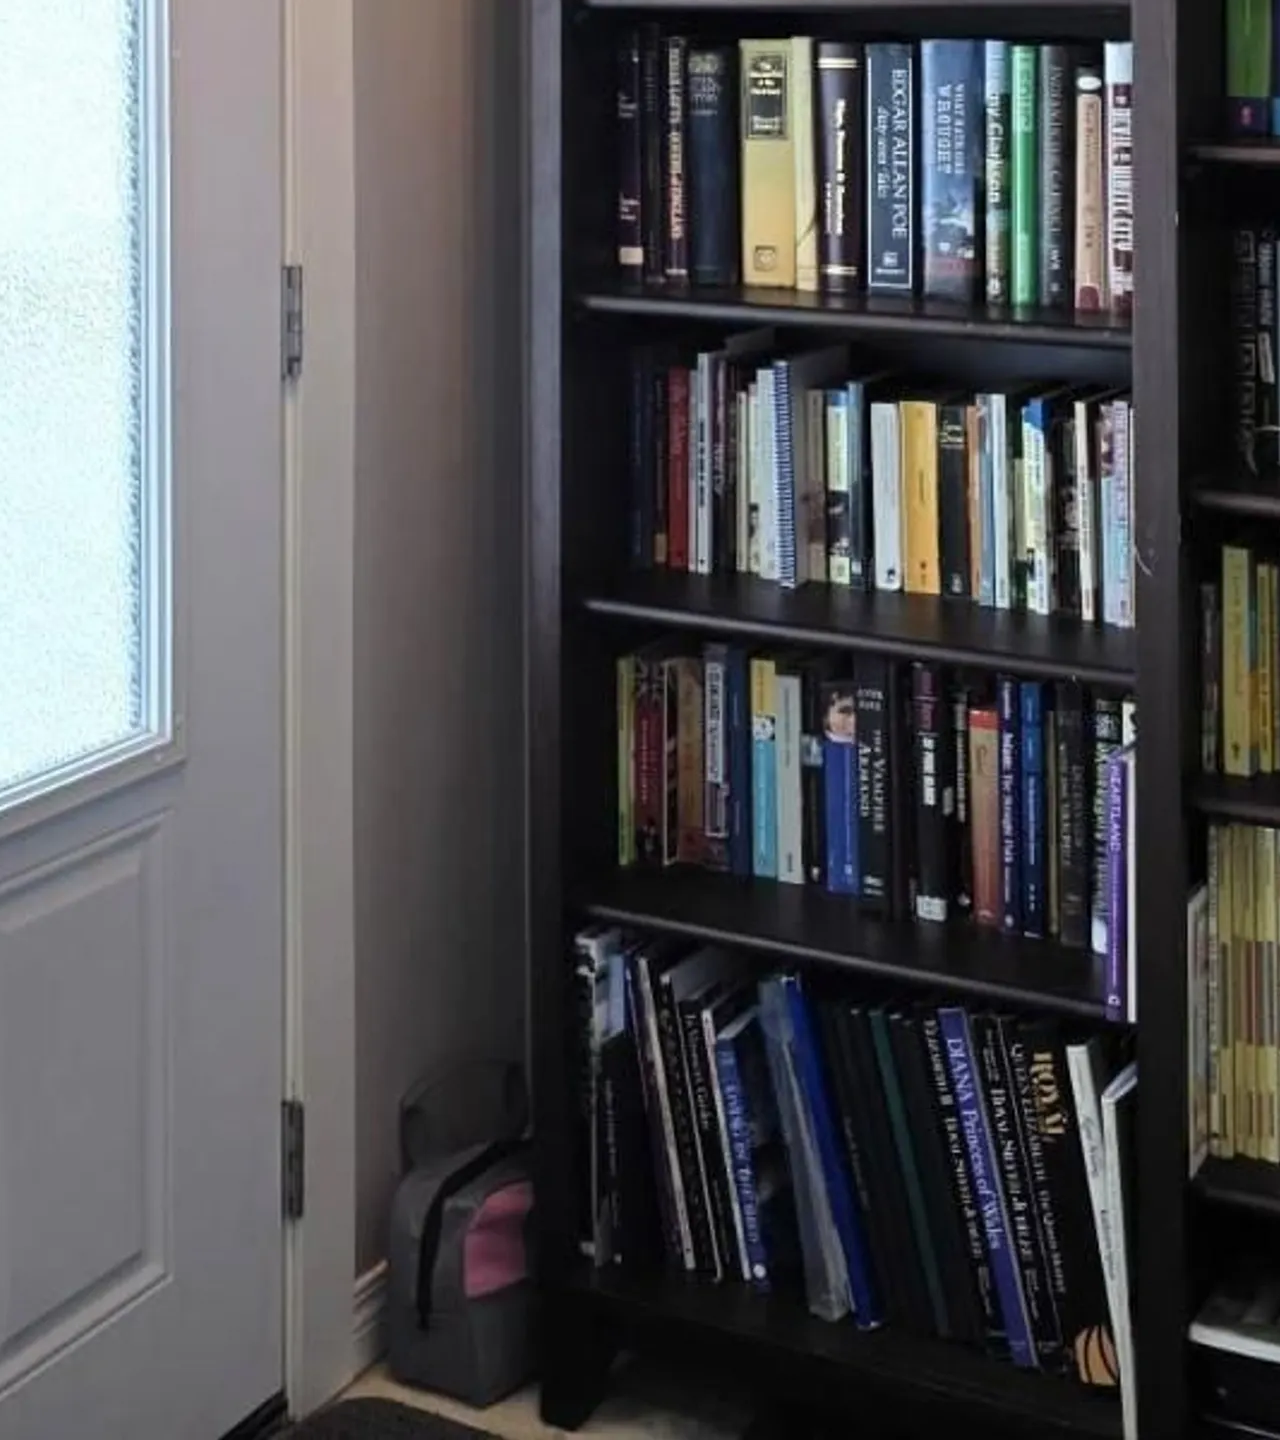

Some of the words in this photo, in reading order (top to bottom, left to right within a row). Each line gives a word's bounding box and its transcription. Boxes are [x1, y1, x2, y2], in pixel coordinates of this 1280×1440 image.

[891, 68, 909, 132] EDGAR
[936, 83, 952, 174] WROUGHT
[953, 83, 966, 115] WHAT
[891, 136, 909, 198] ALLAN
[988, 121, 1005, 204] Clarkson
[891, 203, 909, 240] POE
[858, 742, 872, 818] ARMAND
[873, 757, 886, 833] VAMPIRE
[1109, 764, 1123, 853] HEARTLAND
[947, 1037, 973, 1103] DIANA
[961, 1108, 988, 1177] Princess
[1023, 1097, 1045, 1182] ELIZABETH
[976, 1178, 994, 1195] of
[981, 1201, 1002, 1251] Wales
